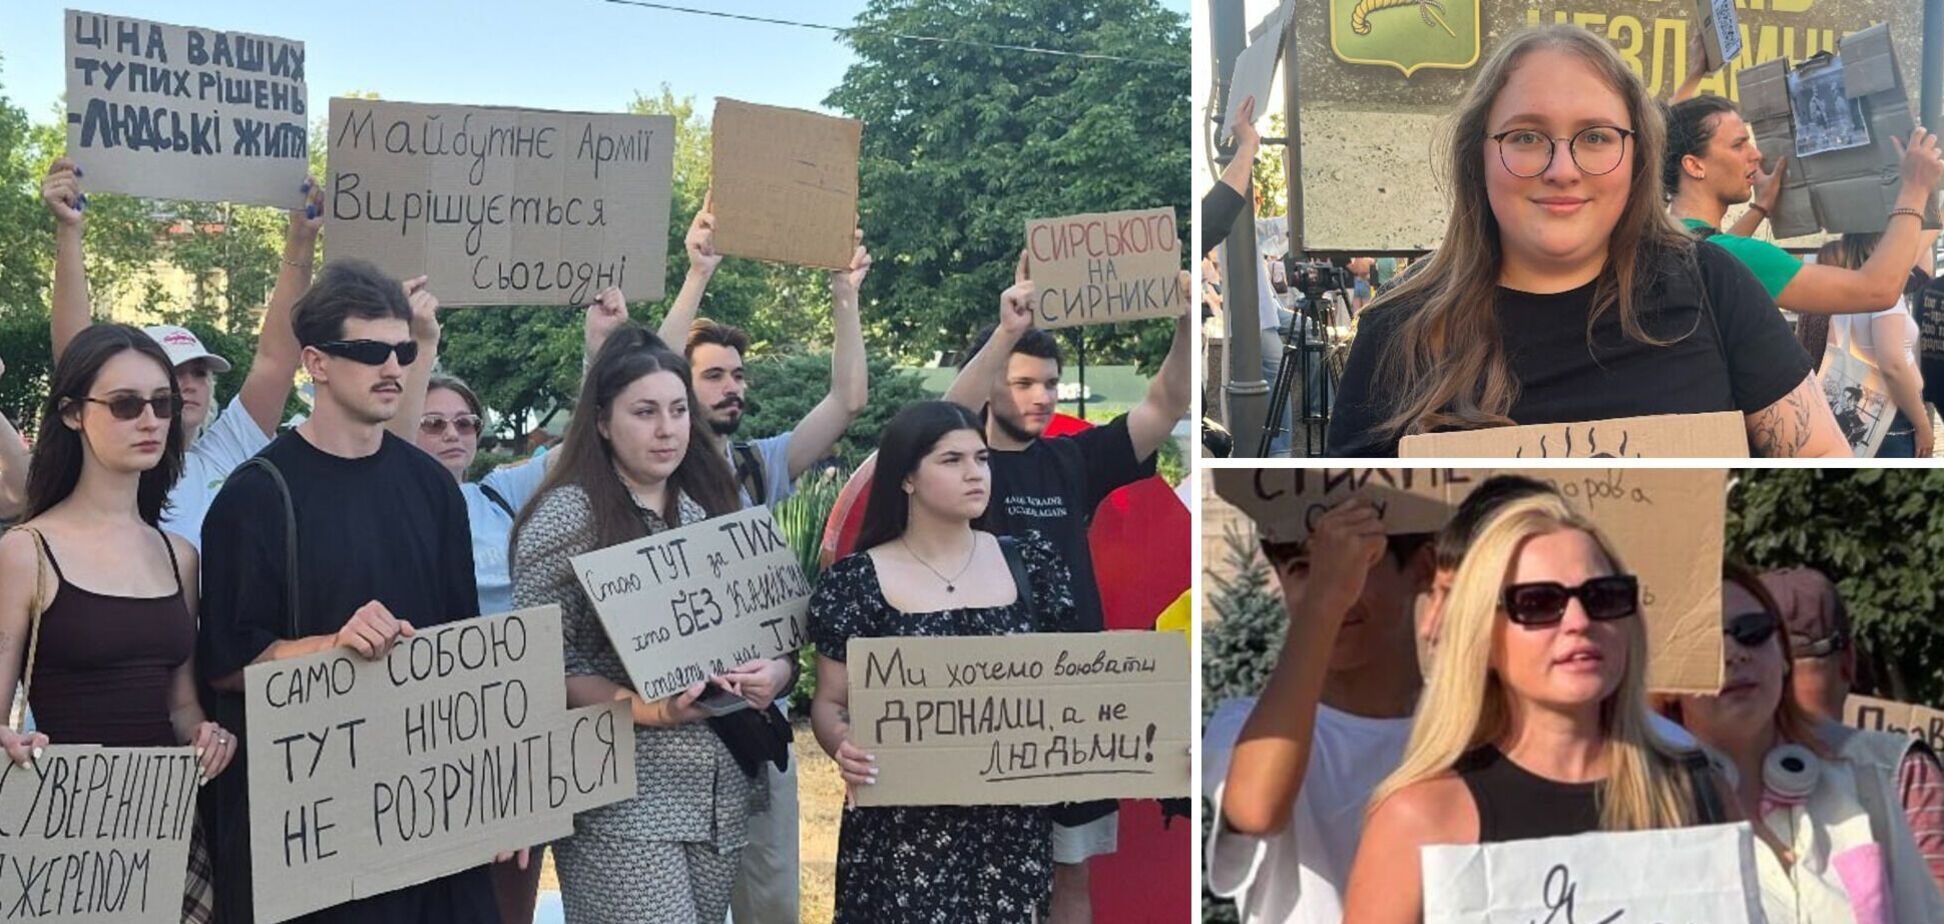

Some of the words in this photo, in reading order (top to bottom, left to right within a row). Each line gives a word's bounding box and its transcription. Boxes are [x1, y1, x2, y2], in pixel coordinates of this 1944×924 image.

[187, 30, 304, 82] ВАШИХ
[75, 57, 191, 98] ТУПИХ
[199, 70, 305, 115] РІШЕНЬ
[232, 118, 307, 158] ЖИТТЯ
[337, 110, 556, 186] Майбутнє
[577, 122, 654, 179] Армії
[333, 172, 607, 256] Вирішується
[1031, 214, 1176, 262] СИРСЬКОГО
[472, 254, 627, 306] Сьогодні
[1088, 258, 1118, 284] НА
[1040, 275, 1180, 322] СИРНИКИ
[1547, 468, 1653, 511] орова
[585, 569, 641, 602] Стою
[637, 537, 691, 584] ТУТ
[706, 551, 729, 579] за
[719, 517, 787, 560] ТИХ
[632, 626, 671, 652] хто
[671, 588, 723, 637] БЕЗ
[760, 613, 806, 652] ТА
[265, 657, 356, 708] САМО
[387, 615, 527, 686] СОБОЮ
[865, 647, 927, 689] Ми
[946, 657, 1044, 688] хочемо
[1054, 649, 1156, 677] воювати
[273, 718, 366, 783] ТУТ
[405, 678, 528, 755] НІЧОГО
[1062, 705, 1084, 724] а
[1098, 701, 1130, 722] не
[980, 722, 1157, 776] ЛЮДЬМИ!
[284, 797, 338, 867] НЕ
[373, 710, 618, 846] РОЗРУЛИТЬСЯ
[0, 848, 151, 919] ЖЕРЕЛОМ
